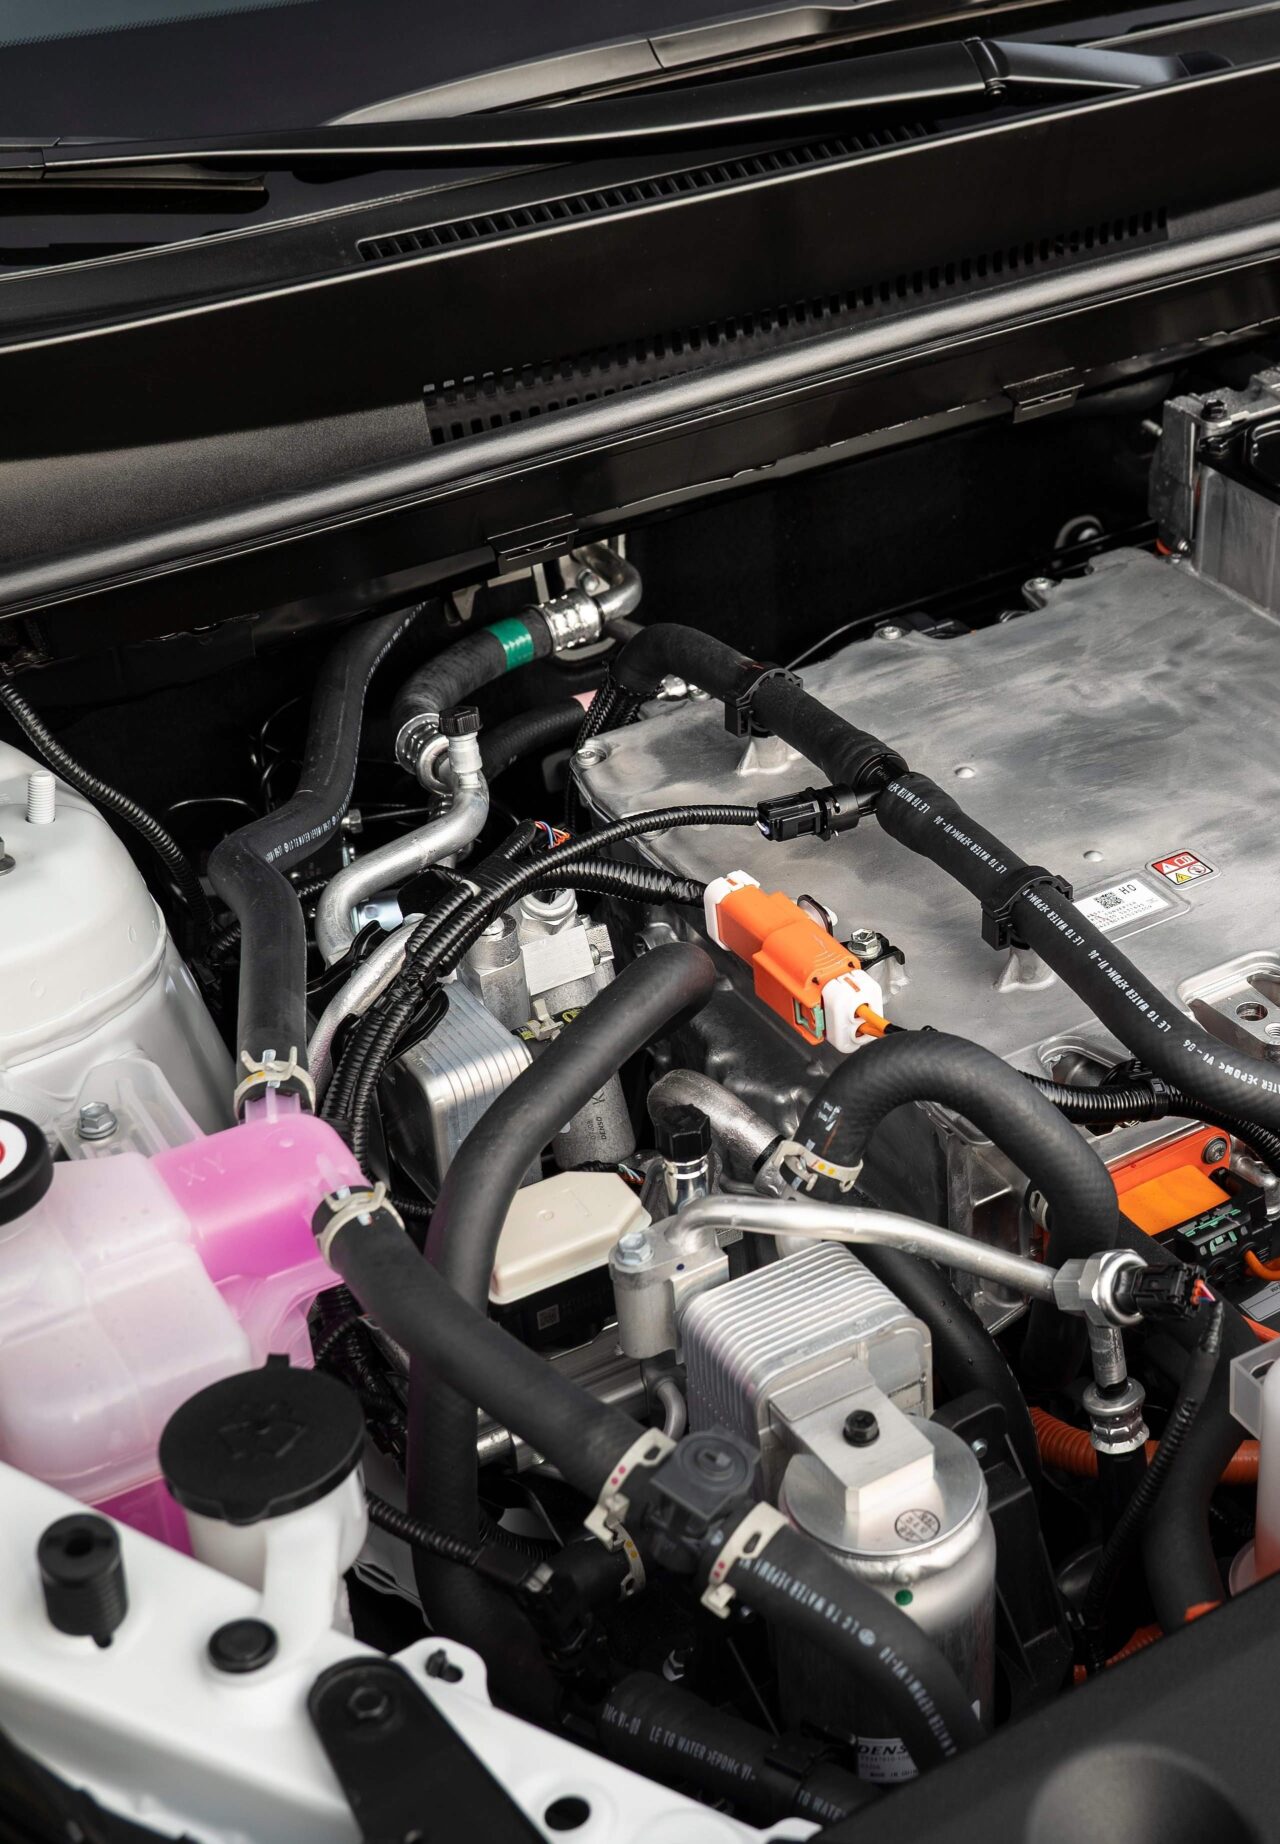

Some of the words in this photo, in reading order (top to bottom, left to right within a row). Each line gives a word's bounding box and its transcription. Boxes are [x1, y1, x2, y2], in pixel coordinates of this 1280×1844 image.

[896, 787, 916, 803] WATER
[917, 802, 931, 814] LE
[969, 843, 991, 862] WATER
[987, 858, 999, 868] TG
[995, 864, 1008, 875] LE
[1046, 910, 1068, 931] WATER
[1064, 927, 1077, 939] TG
[1072, 934, 1086, 947] LE
[1124, 988, 1150, 1012] WATER
[1146, 1009, 1161, 1022] TG
[1157, 1019, 1172, 1033] LE
[596, 1116, 607, 1140] DENSO
[788, 1580, 827, 1613] WATER
[649, 1726, 664, 1742] LE
[661, 1731, 677, 1748] TG
[675, 1736, 708, 1761] WATER
[858, 1745, 908, 1755] DENS
